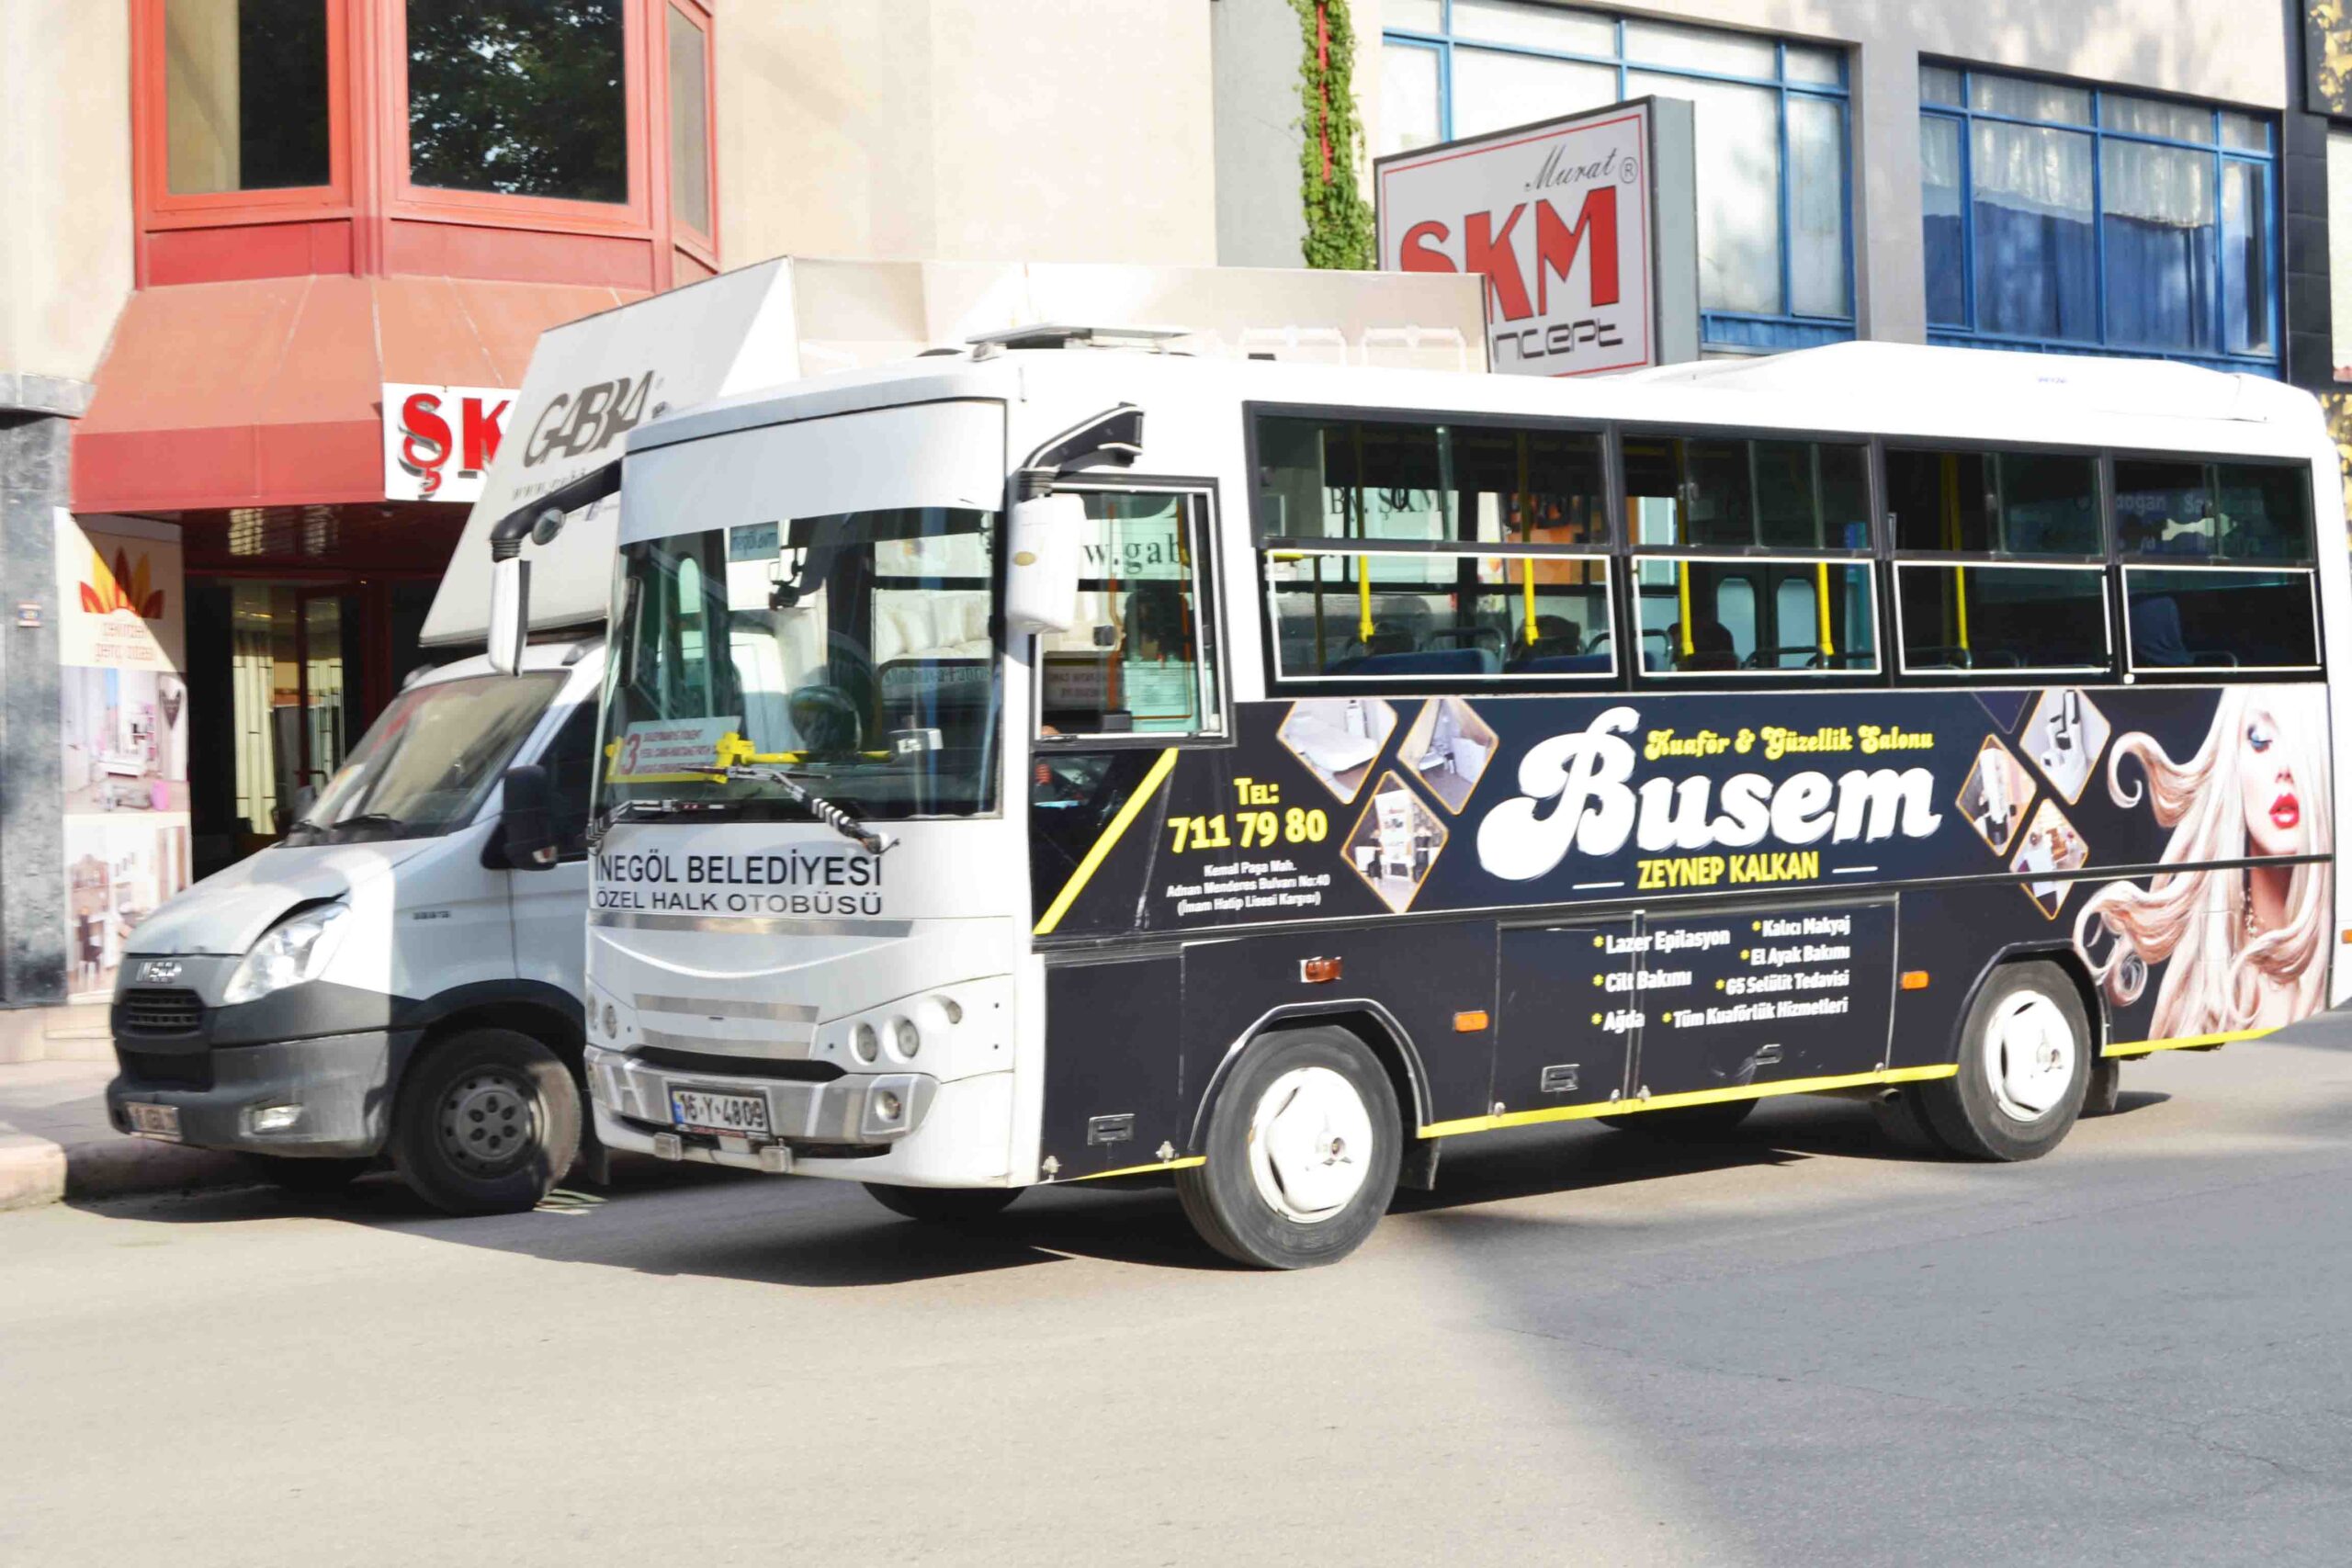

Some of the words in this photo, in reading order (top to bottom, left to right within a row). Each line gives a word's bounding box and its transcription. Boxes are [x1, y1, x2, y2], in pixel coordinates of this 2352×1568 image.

[1524, 144, 1617, 192] Murat
[620, 732, 642, 775] 3
[1644, 728, 1730, 761] Kuaför
[1734, 728, 1756, 754] &
[1760, 726, 1853, 761] Güzellik
[1857, 725, 1934, 754] Salonu
[1476, 706, 1942, 881] Busem
[1168, 813, 1231, 854] 711
[1237, 811, 1280, 849] 79
[1284, 808, 1329, 843] 80
[1204, 863, 1239, 877] Kemal
[1271, 860, 1297, 872] Mah.
[1636, 855, 1725, 890] ZEYNEP
[1729, 851, 1818, 884] KALKAN
[1166, 885, 1203, 897] Adnan
[1204, 880, 1257, 895] Menderes
[596, 886, 645, 908] ÖZEL
[652, 893, 718, 911] HALK
[728, 891, 882, 916] OTOBÜSÜ
[1214, 897, 1244, 911] Hatip
[1245, 894, 1277, 908] Lisesi
[1804, 916, 1850, 936] Makyaj
[1606, 934, 1653, 954] Lazer
[1655, 930, 1731, 953] Epilasyon
[1750, 949, 1767, 965] El
[1768, 946, 1801, 967] Ayak
[1605, 973, 1635, 992] Cilt
[1793, 970, 1850, 989] Tedavisi
[1603, 1010, 1645, 1033] Ağda
[1674, 1010, 1705, 1028] Tüm
[1706, 1002, 1776, 1026] Kuaförlük
[1777, 997, 1849, 1018] Hizmetleri
